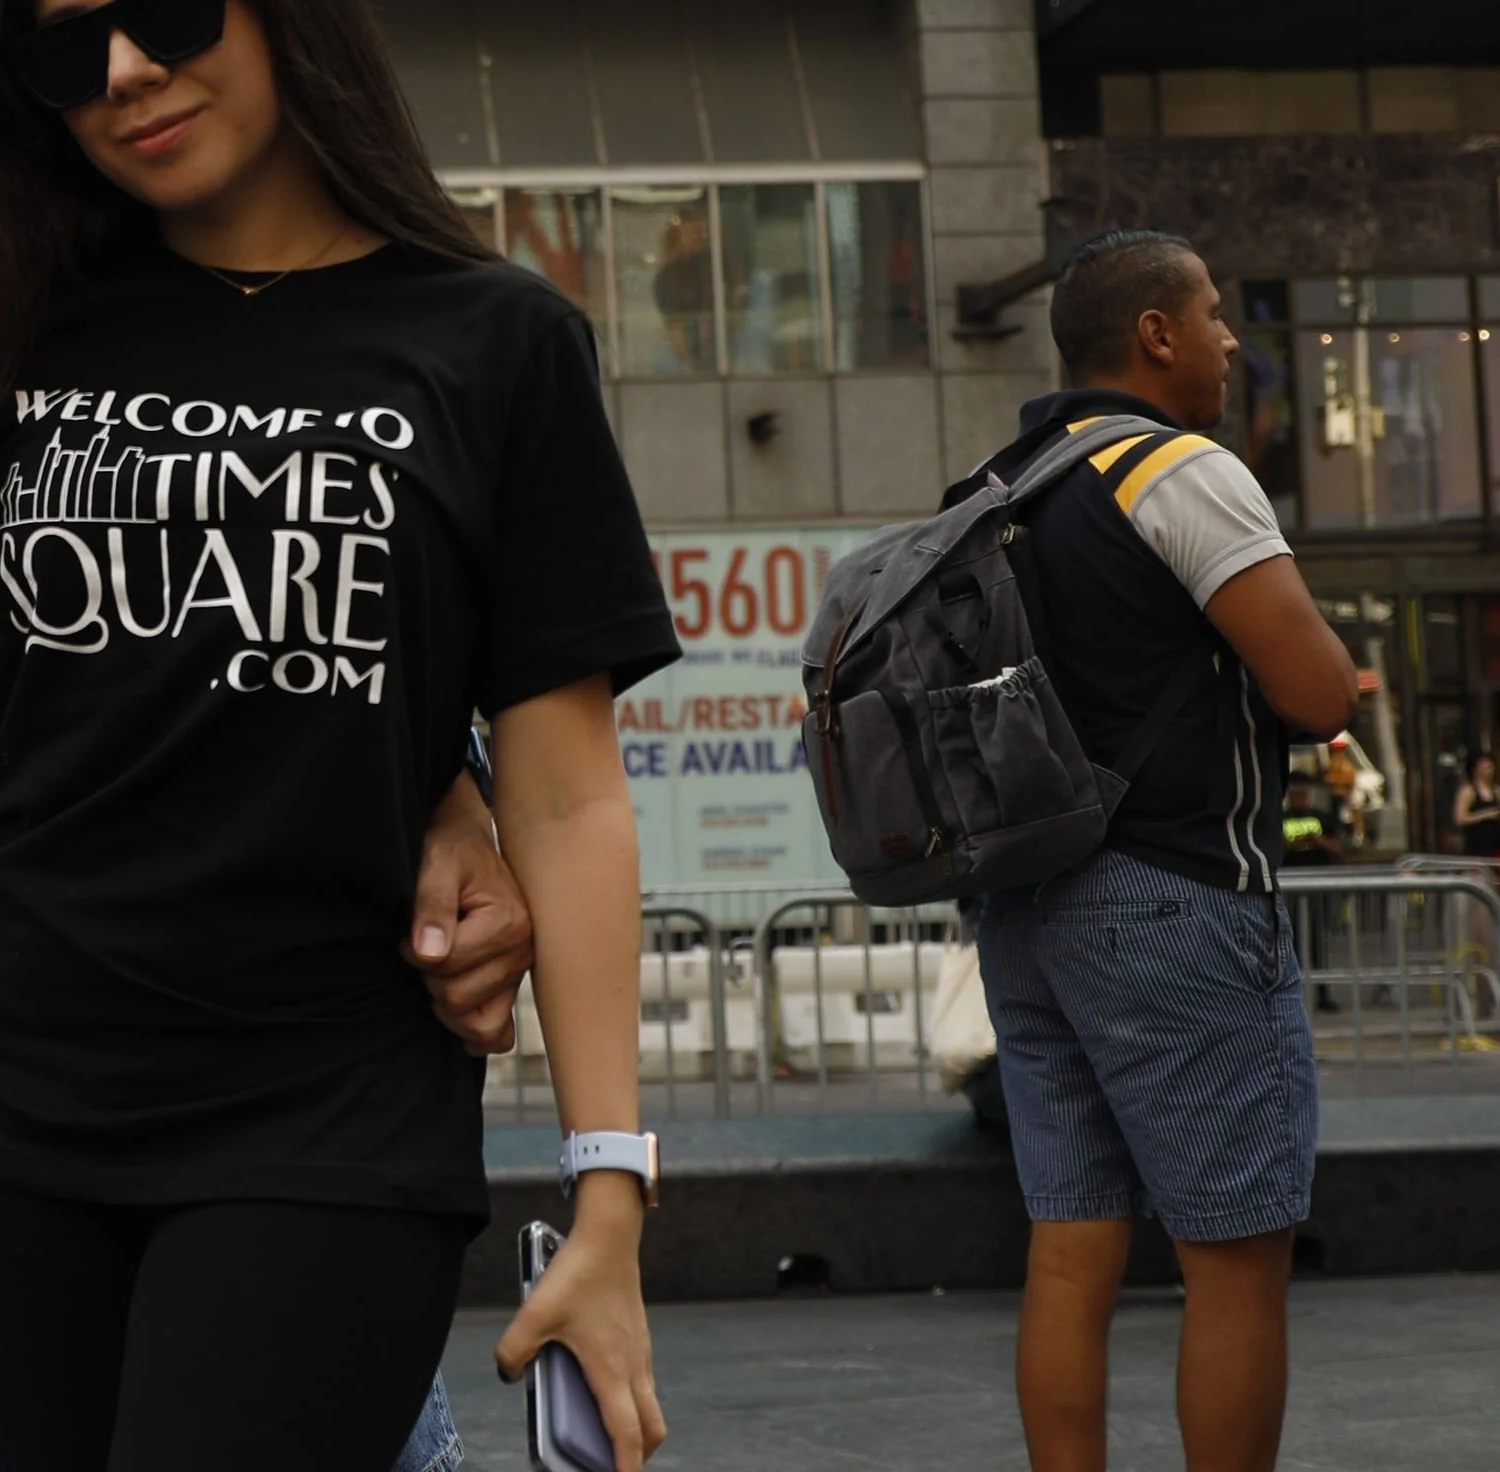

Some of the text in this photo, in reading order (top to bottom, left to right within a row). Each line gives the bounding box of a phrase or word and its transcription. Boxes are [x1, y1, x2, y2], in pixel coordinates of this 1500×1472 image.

[146, 450, 398, 531] TIMES
[0, 527, 390, 655] SQUARE
[656, 545, 808, 639] 560
[210, 649, 386, 705] .COM
[619, 693, 808, 733] AIL/RESTA
[624, 738, 810, 778] CE AVAILA
